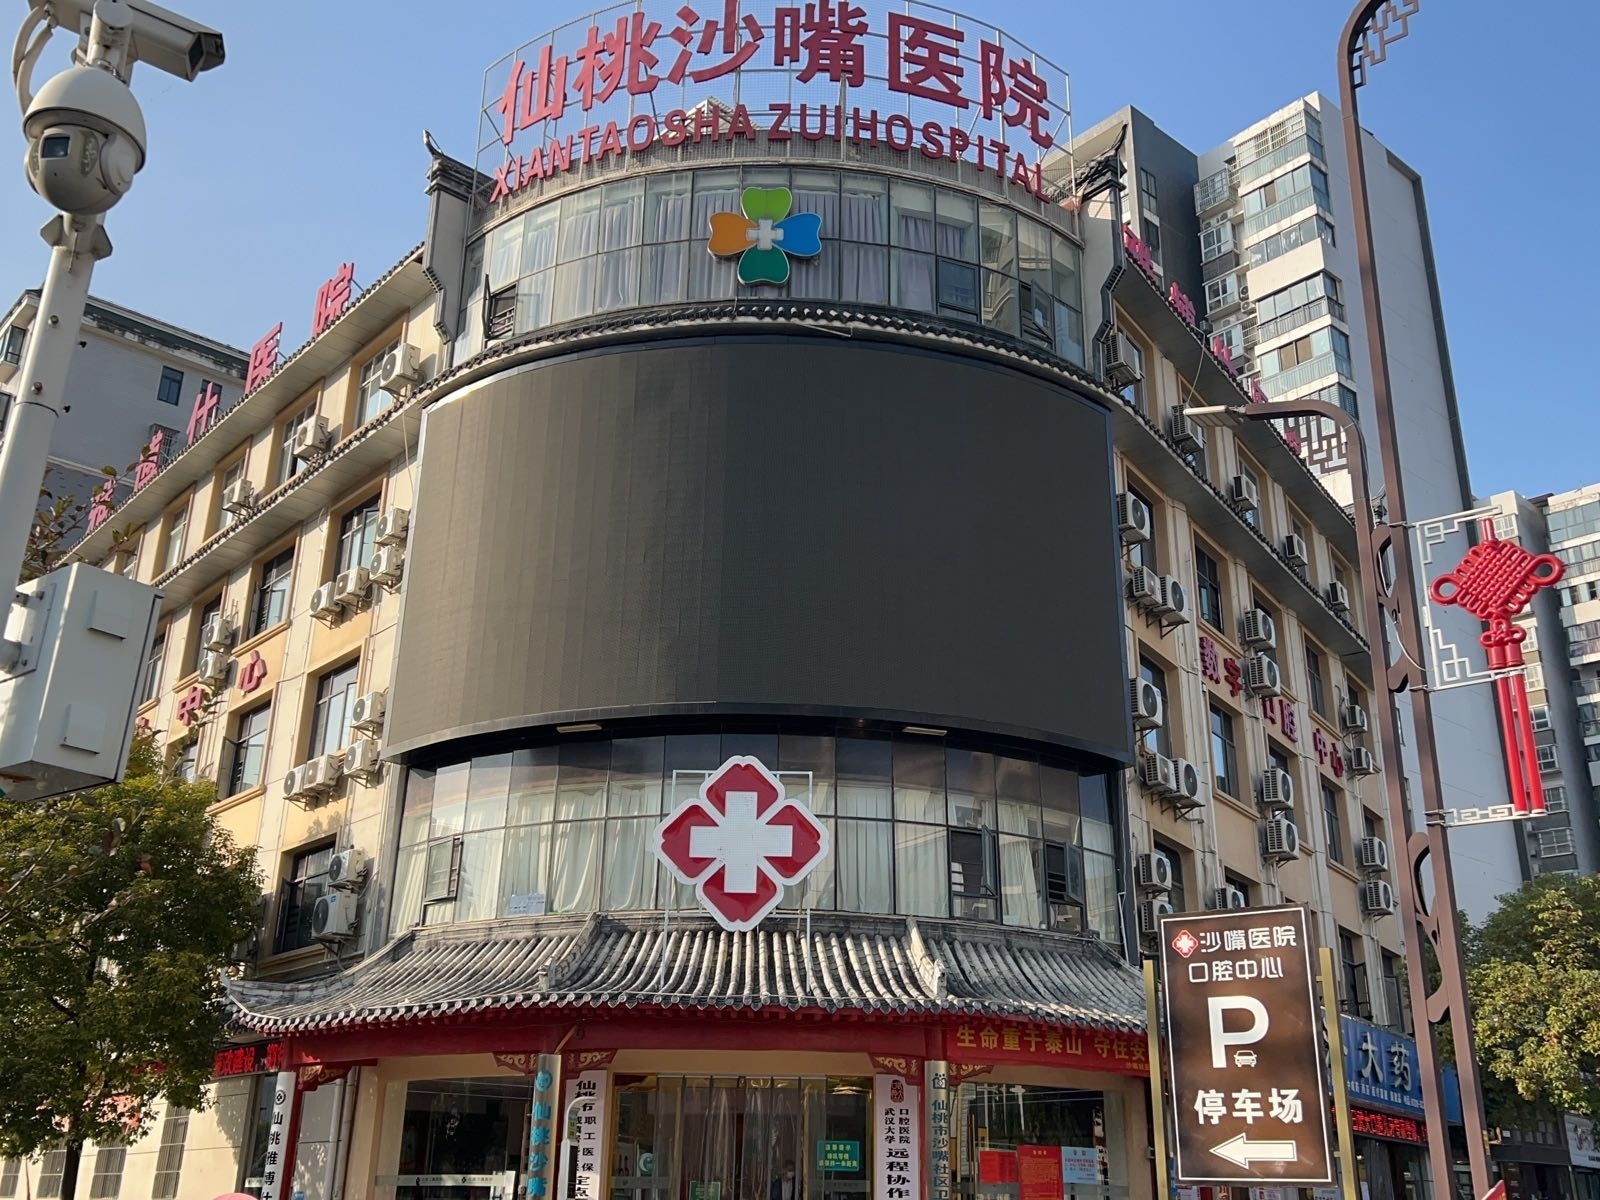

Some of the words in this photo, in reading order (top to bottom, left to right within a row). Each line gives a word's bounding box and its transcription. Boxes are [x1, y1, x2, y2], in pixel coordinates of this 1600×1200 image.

[498, 0, 1053, 149] 仙桃沙嘴医院
[1200, 926, 1297, 952] 沙嘴医院
[1189, 957, 1283, 983] 口腔中心
[957, 1024, 1083, 1056] 生命重于泰山
[1208, 995, 1269, 1068] P
[1194, 1088, 1303, 1125] 停车场
[884, 1107, 896, 1145] 武汉大学
[898, 1108, 911, 1145] 口腔医院
[886, 1148, 911, 1199] 远程协作
